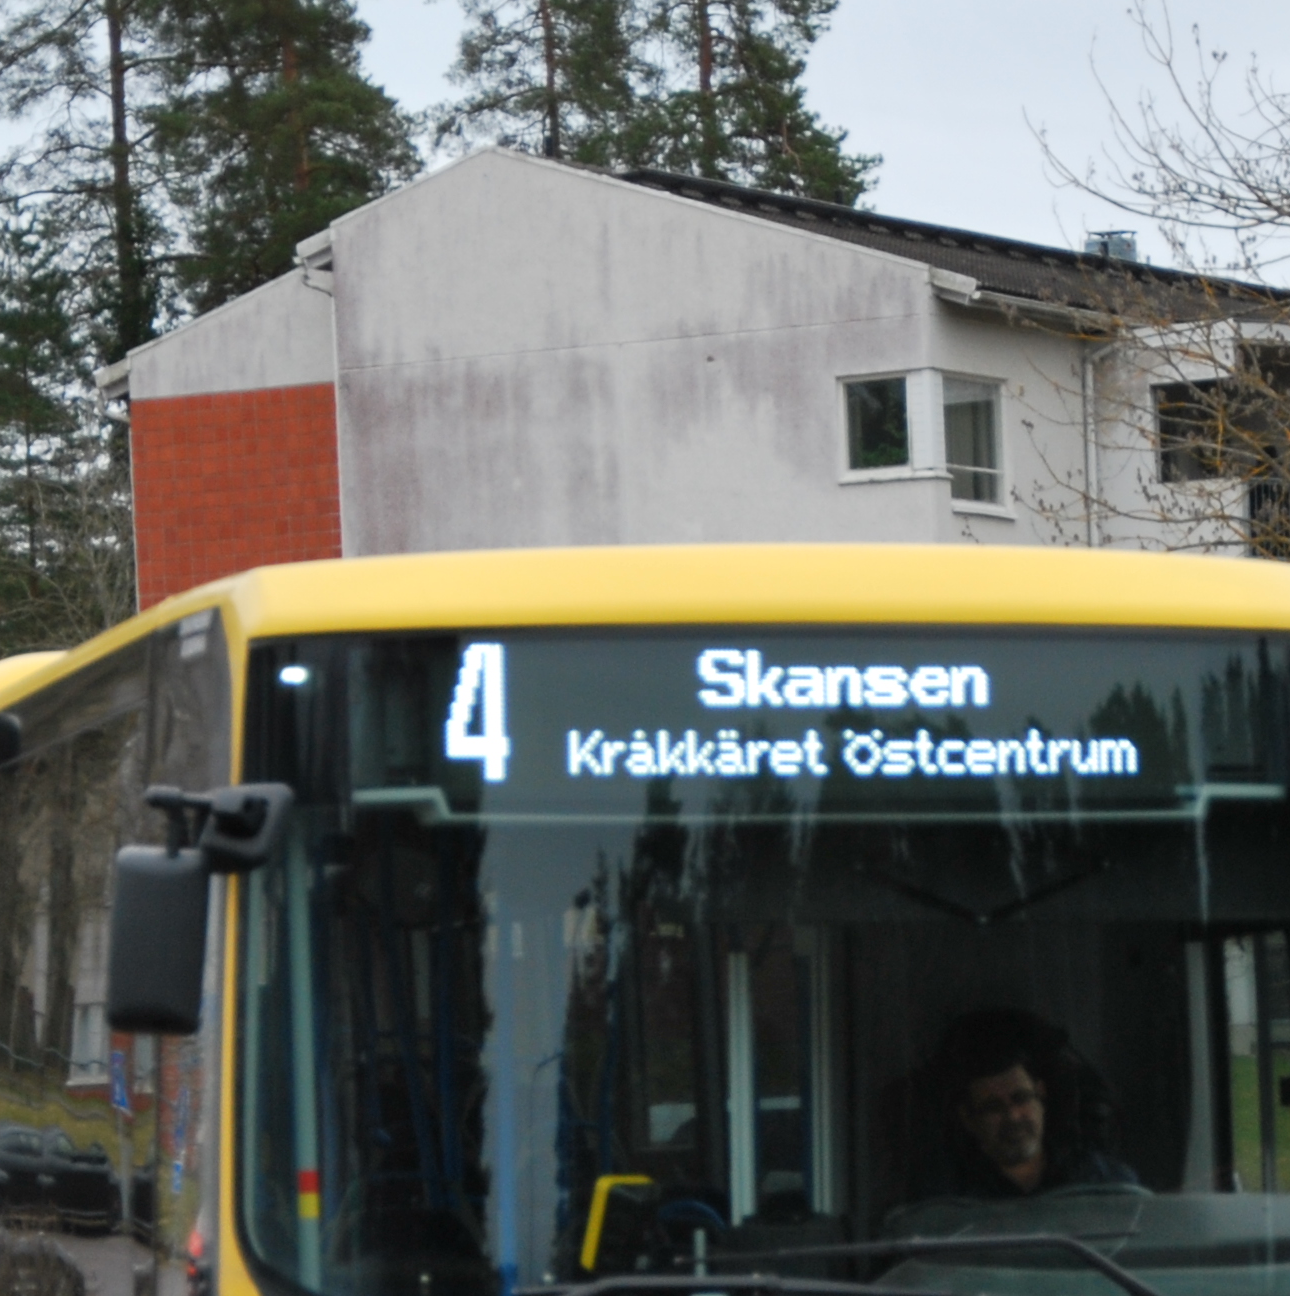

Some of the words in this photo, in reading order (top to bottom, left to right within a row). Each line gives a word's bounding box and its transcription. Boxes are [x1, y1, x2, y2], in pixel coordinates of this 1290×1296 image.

[698, 648, 990, 707] Skansen
[446, 642, 511, 781] 4
[567, 728, 829, 777] Kråkkäret
[842, 728, 1138, 776] Östcentrum
